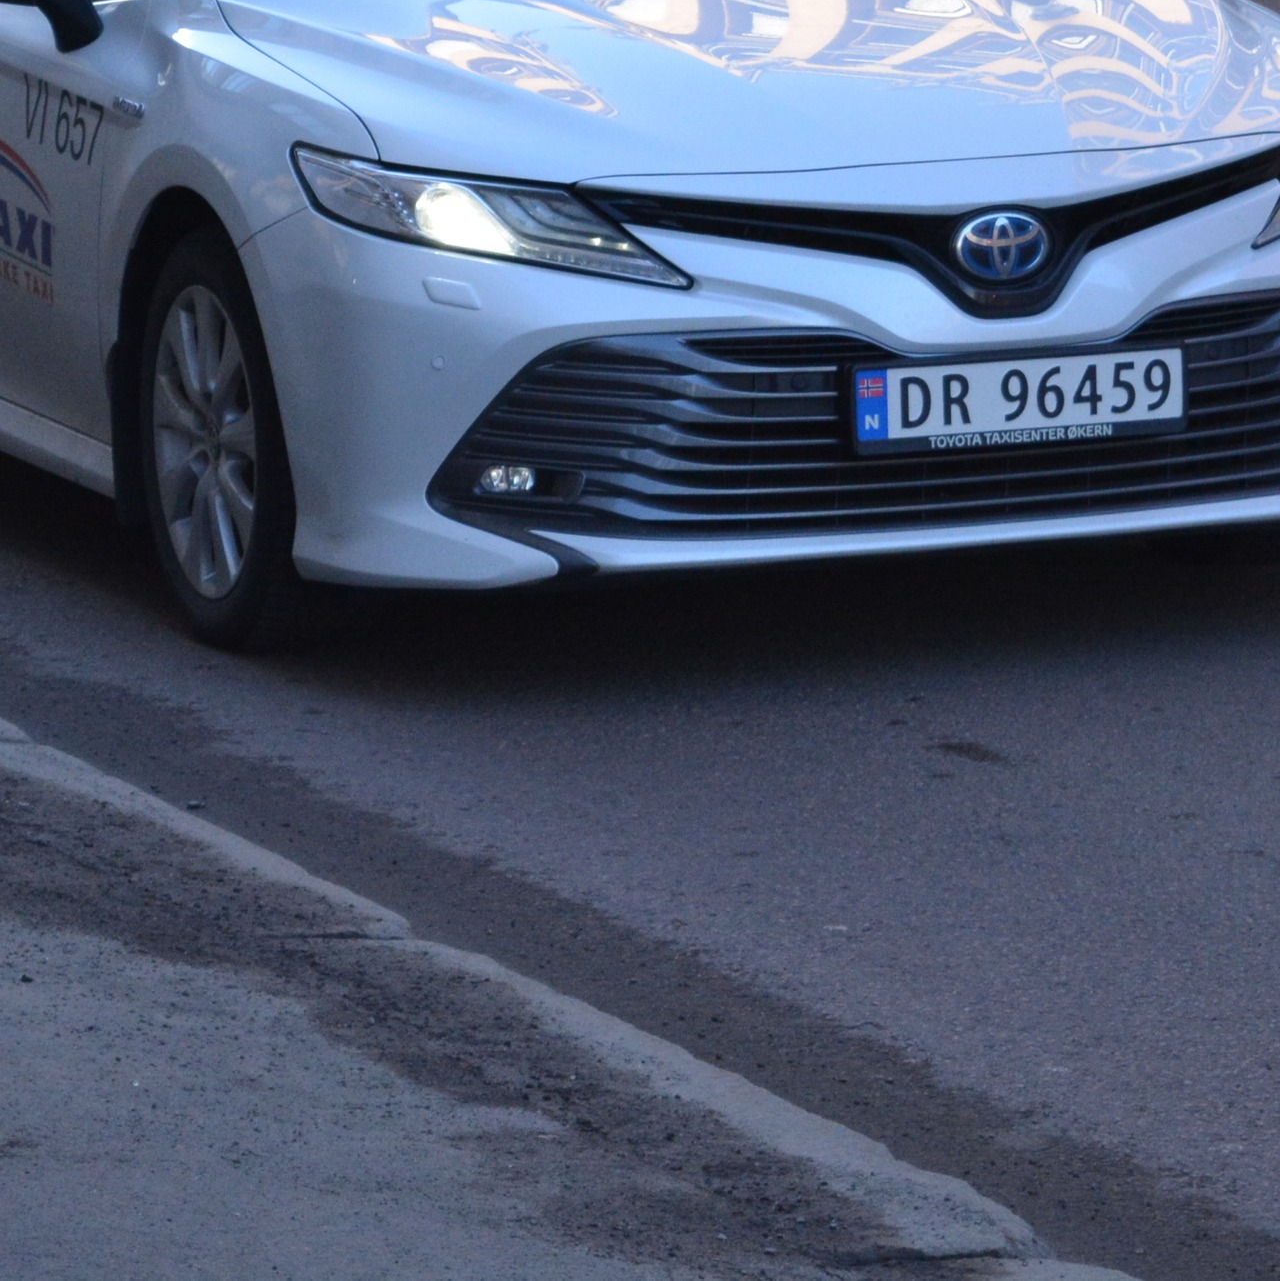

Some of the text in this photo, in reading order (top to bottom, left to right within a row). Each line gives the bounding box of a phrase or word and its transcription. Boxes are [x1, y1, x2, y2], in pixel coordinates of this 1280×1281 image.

[24, 73, 105, 166] VI 657
[23, 270, 55, 304] TAXI
[899, 358, 1171, 430] DR 96459
[864, 414, 880, 431] N
[928, 424, 1113, 450] TOYOTA TAXISENTER ØKERN
